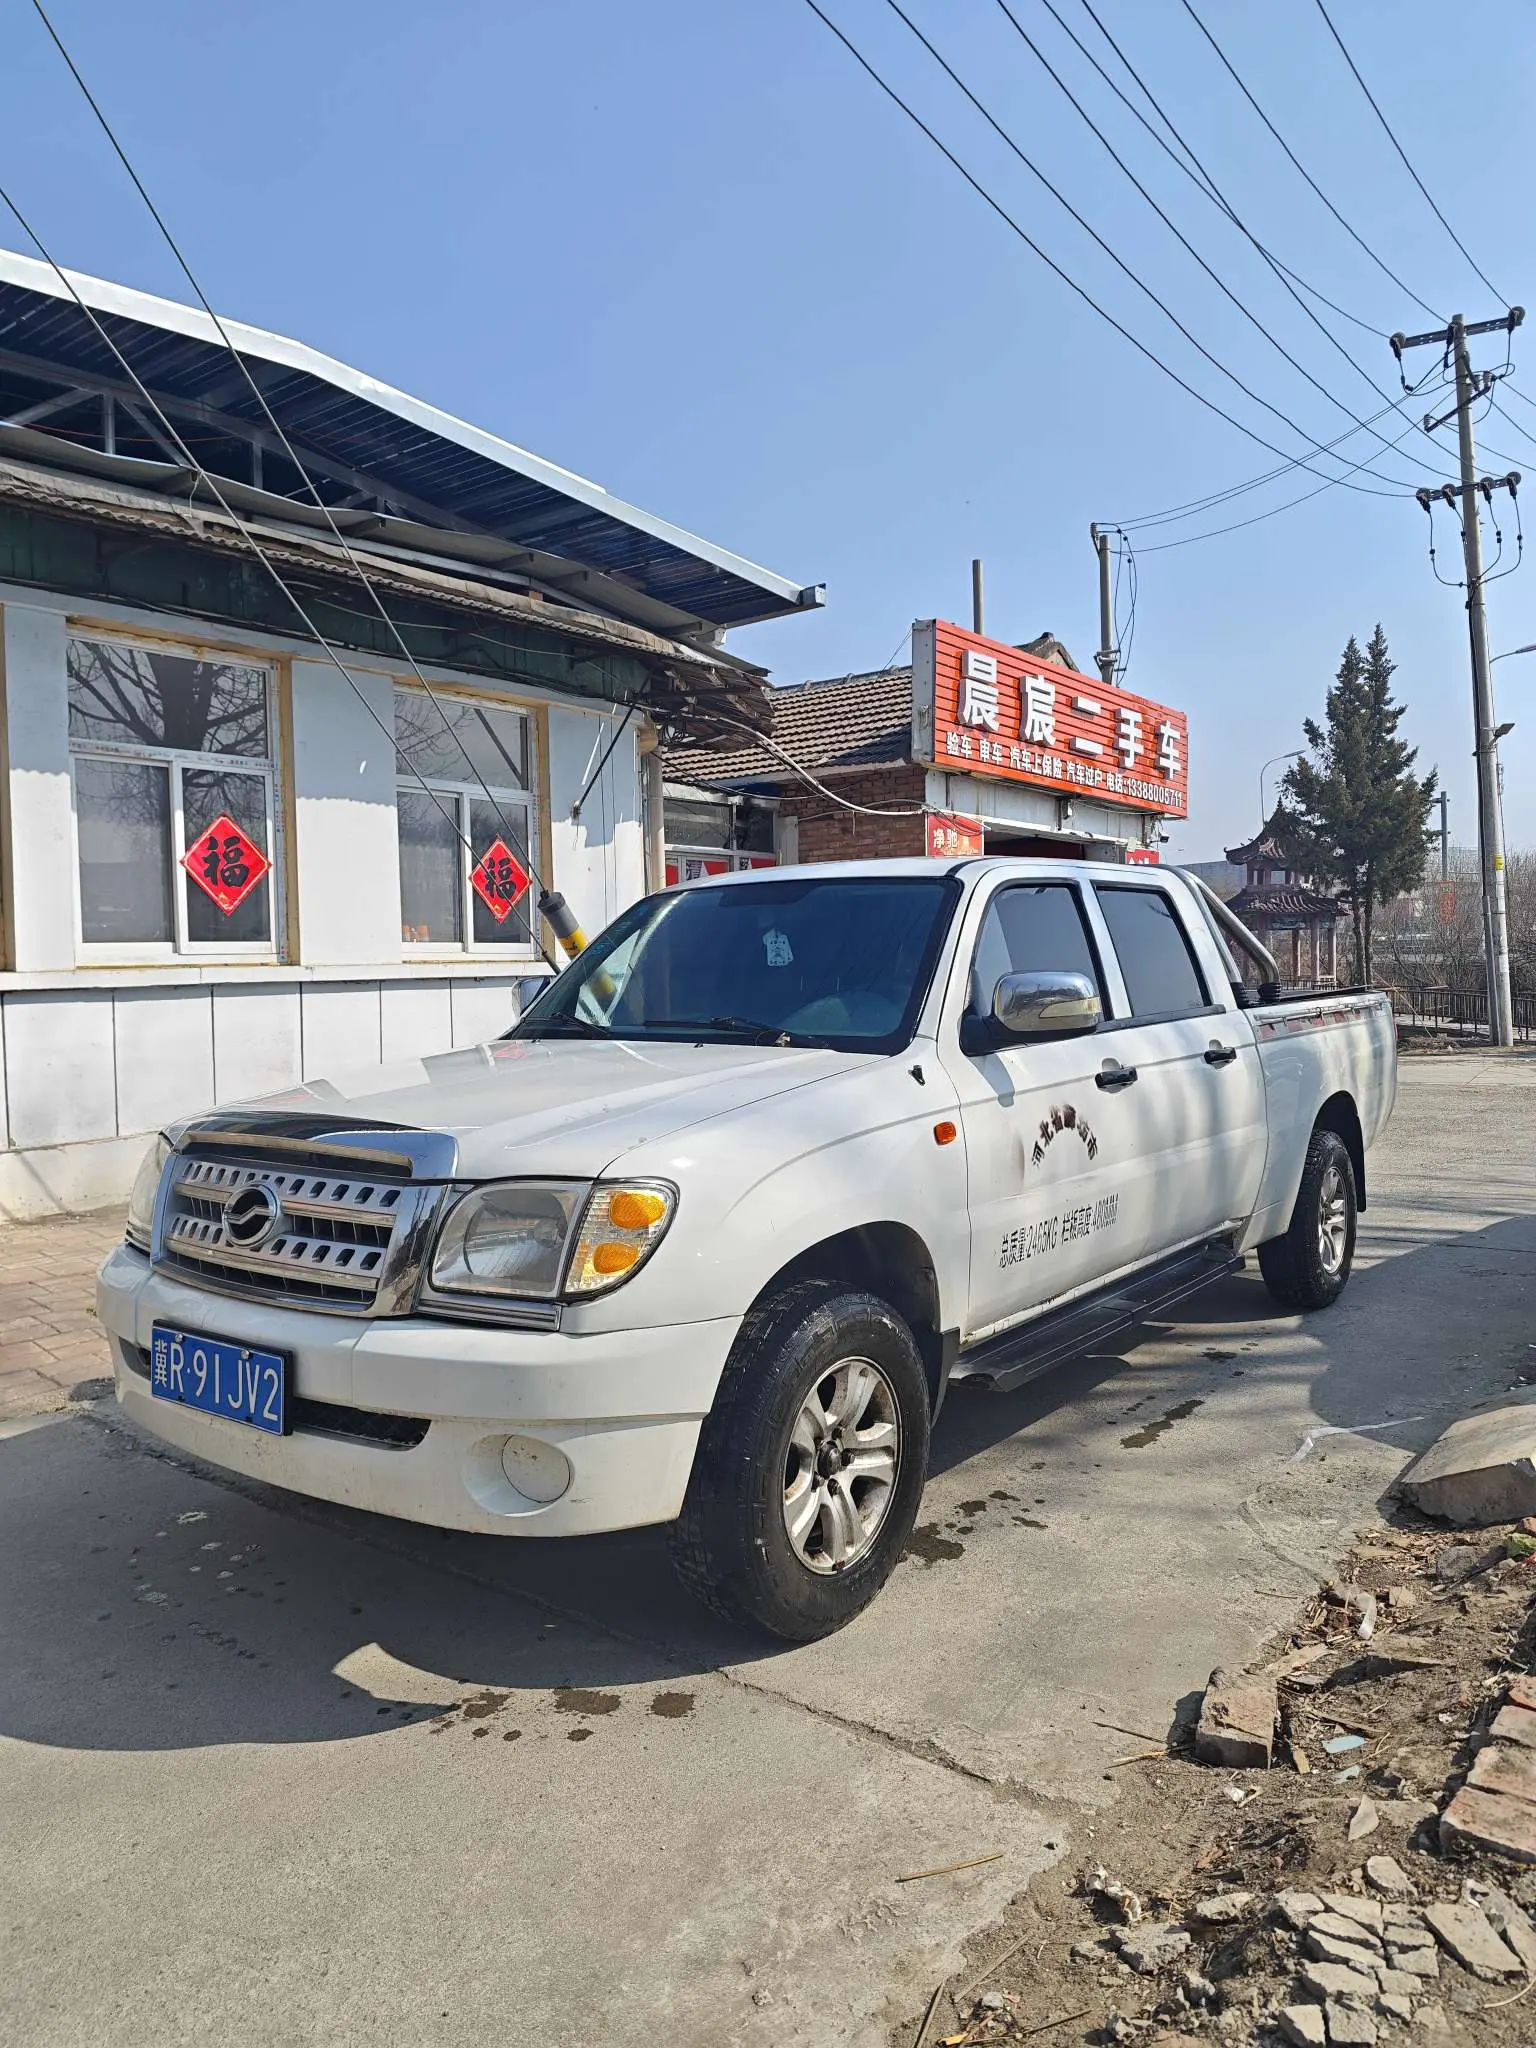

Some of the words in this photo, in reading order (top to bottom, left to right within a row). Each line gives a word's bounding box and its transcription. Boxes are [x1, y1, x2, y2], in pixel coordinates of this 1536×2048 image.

[958, 649, 1181, 780] 晨宸二手车
[947, 731, 972, 758] 验车
[1010, 745, 1062, 779] 汽车上保险
[1066, 760, 1103, 787] 汽车过户
[203, 835, 249, 888] 福
[484, 856, 517, 899] 福
[154, 1338, 278, 1421] 冀R·91JV2
